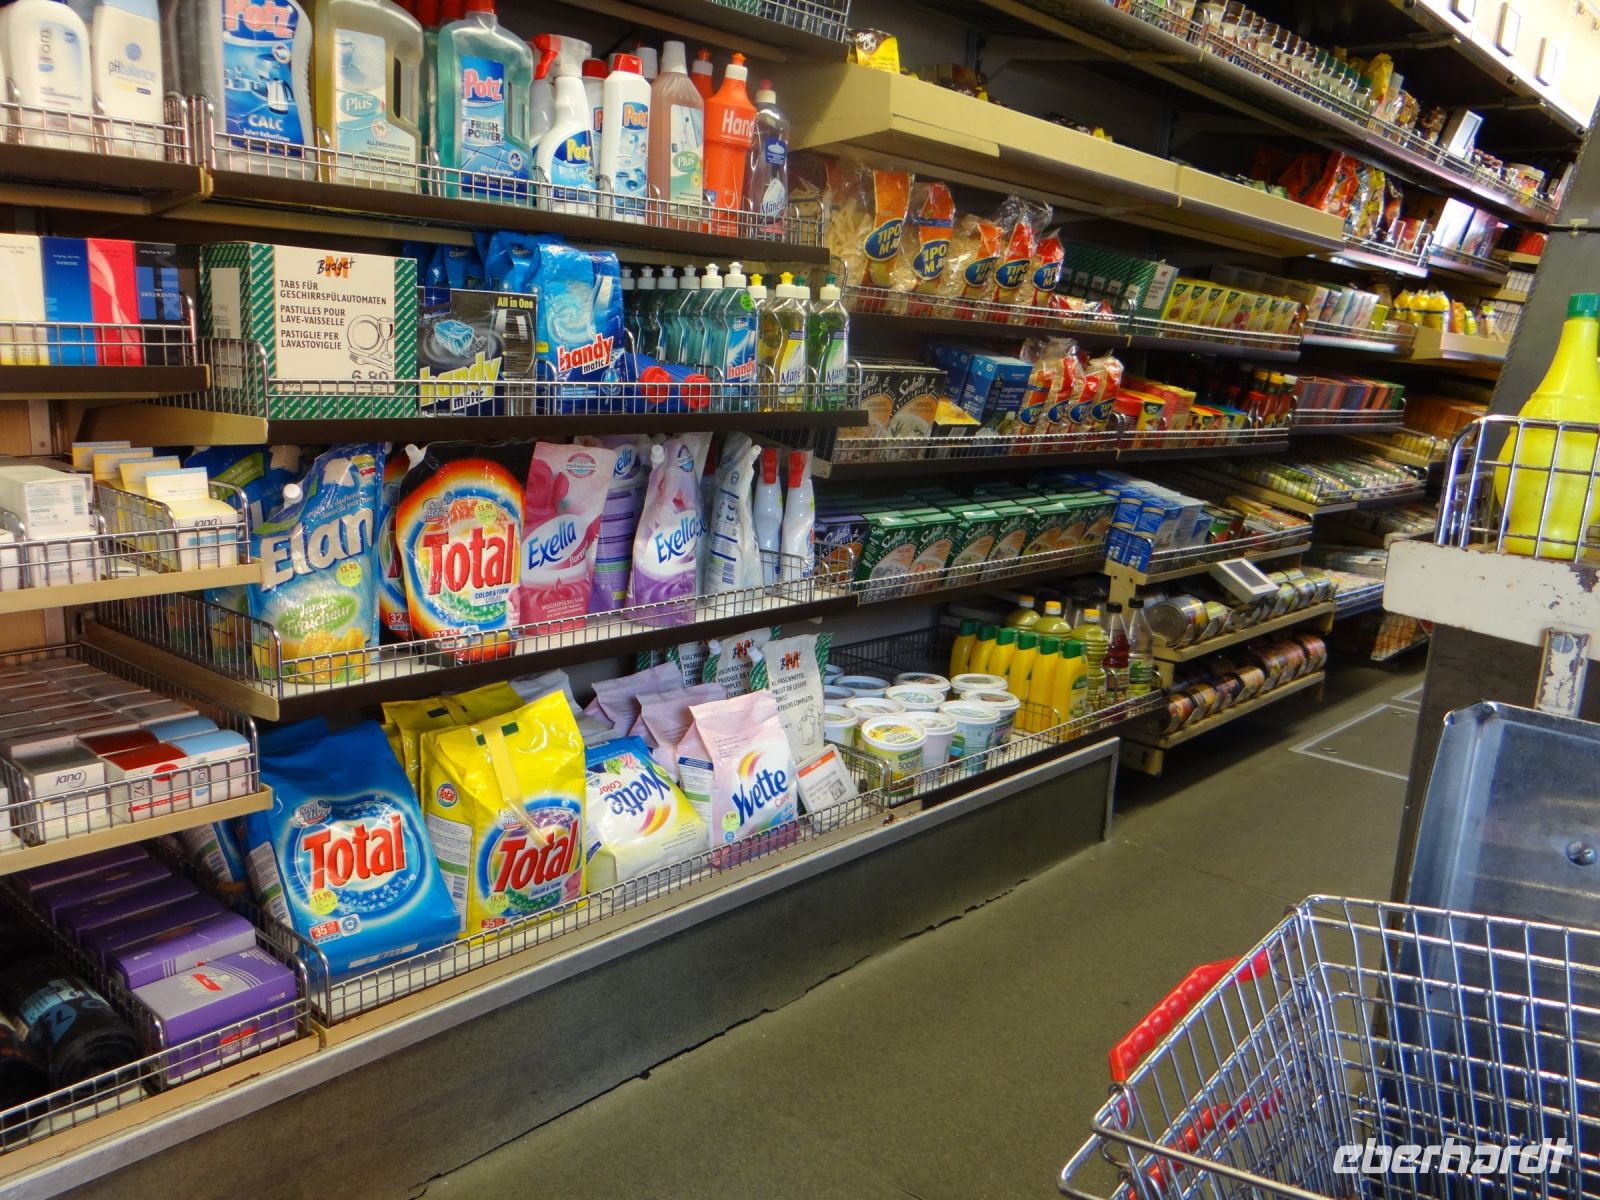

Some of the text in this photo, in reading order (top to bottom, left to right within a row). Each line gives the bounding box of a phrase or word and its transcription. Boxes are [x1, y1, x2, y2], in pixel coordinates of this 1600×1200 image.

[463, 68, 503, 100] Potz
[346, 96, 374, 110] Plus
[247, 113, 284, 131] CALC
[471, 119, 499, 133] FRESH
[468, 128, 501, 142] POWER
[566, 138, 592, 163] Potz
[677, 156, 697, 169] Plus
[877, 224, 901, 243] TIPO
[316, 257, 356, 276] Budget
[1006, 262, 1029, 275] TIPO
[280, 279, 318, 290] TABS FÜR
[280, 290, 387, 305] GESCHIRRSPÜLAUTOMATEN
[497, 296, 535, 309] All in One
[280, 305, 346, 317] PASTILLES POUR
[280, 315, 345, 326] LAVE-VAISSELLE
[281, 329, 339, 341] PASTIGLIE PER
[281, 339, 342, 350] LAVASTOVIGLIE
[557, 332, 614, 371] handy
[583, 358, 604, 373] matic
[527, 520, 577, 570] Exella
[654, 514, 697, 563] Exella
[260, 507, 374, 592] Elan
[423, 523, 516, 596] Total
[439, 788, 455, 802] Total
[599, 780, 623, 796] Color
[604, 766, 671, 816] Yvette
[731, 769, 789, 826] Yvette
[303, 814, 407, 890] Total
[493, 818, 578, 893] Total
[483, 918, 496, 928] 35
[313, 924, 328, 938] 35
